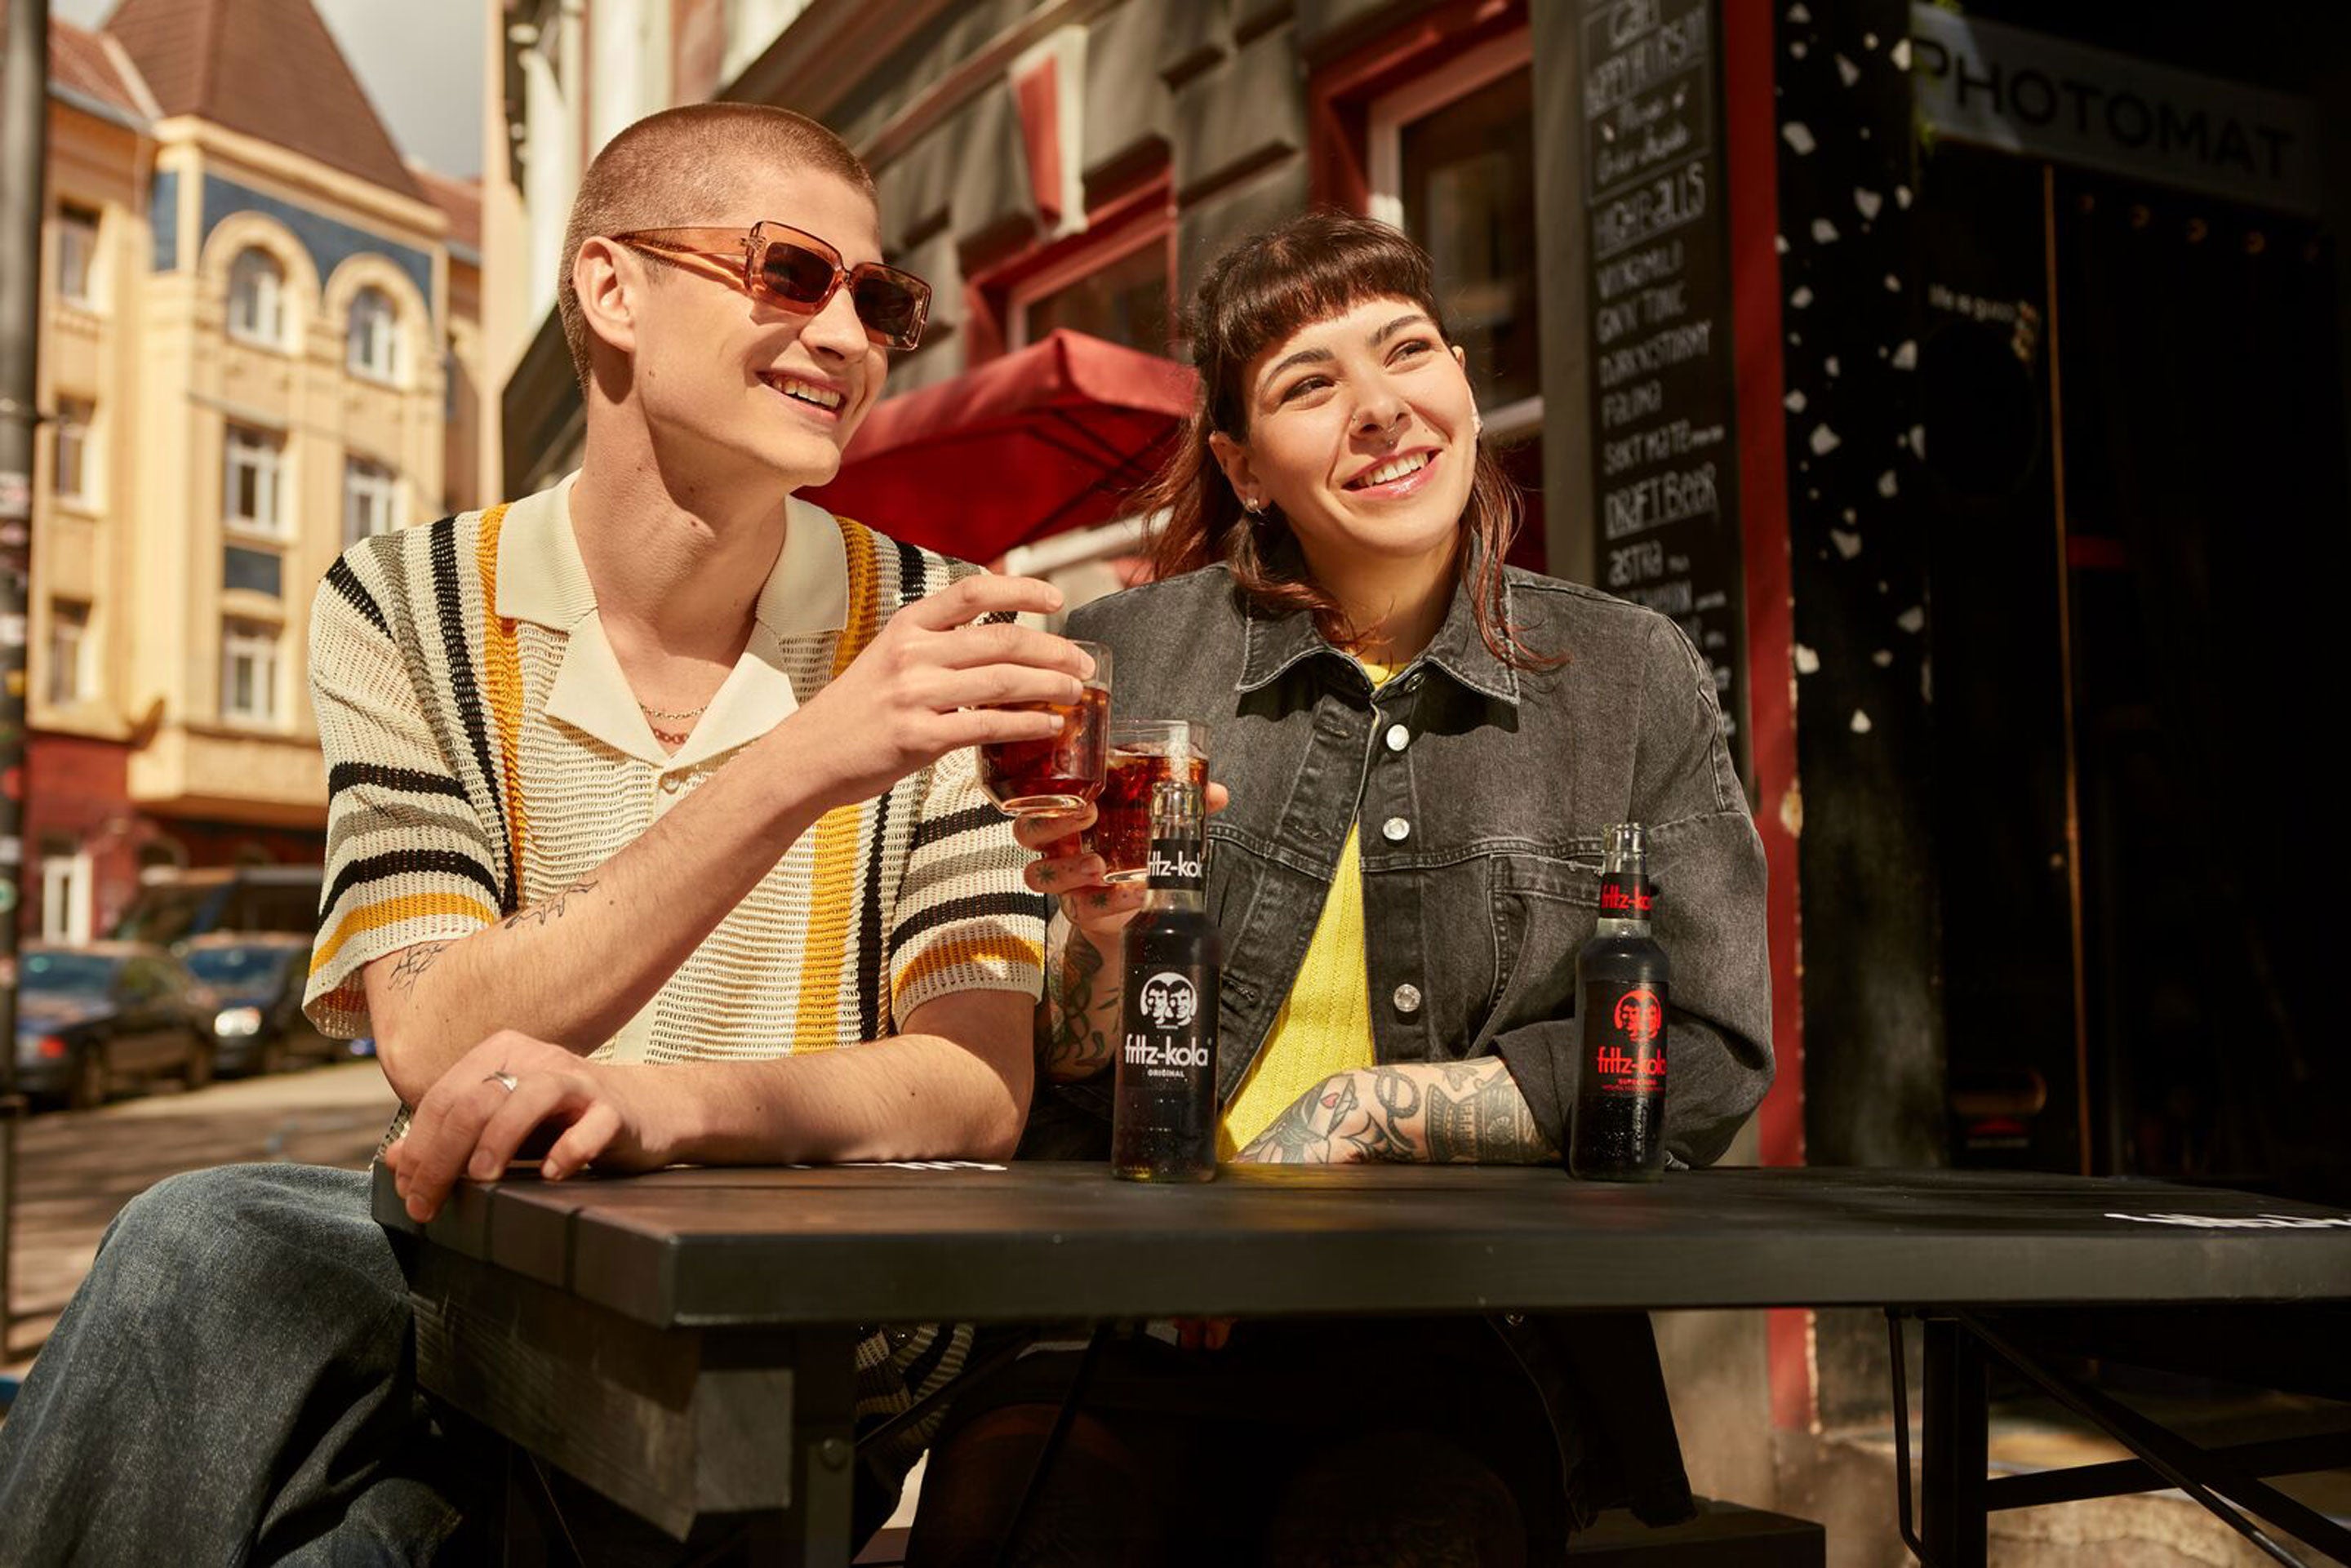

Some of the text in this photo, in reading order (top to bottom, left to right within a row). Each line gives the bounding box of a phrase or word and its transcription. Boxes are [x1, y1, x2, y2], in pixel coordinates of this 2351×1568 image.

[1911, 38, 2295, 179] PHOTOMAT
[1125, 1033, 1209, 1067] fritz-kola
[1147, 1068, 1185, 1078] ORIGINAL
